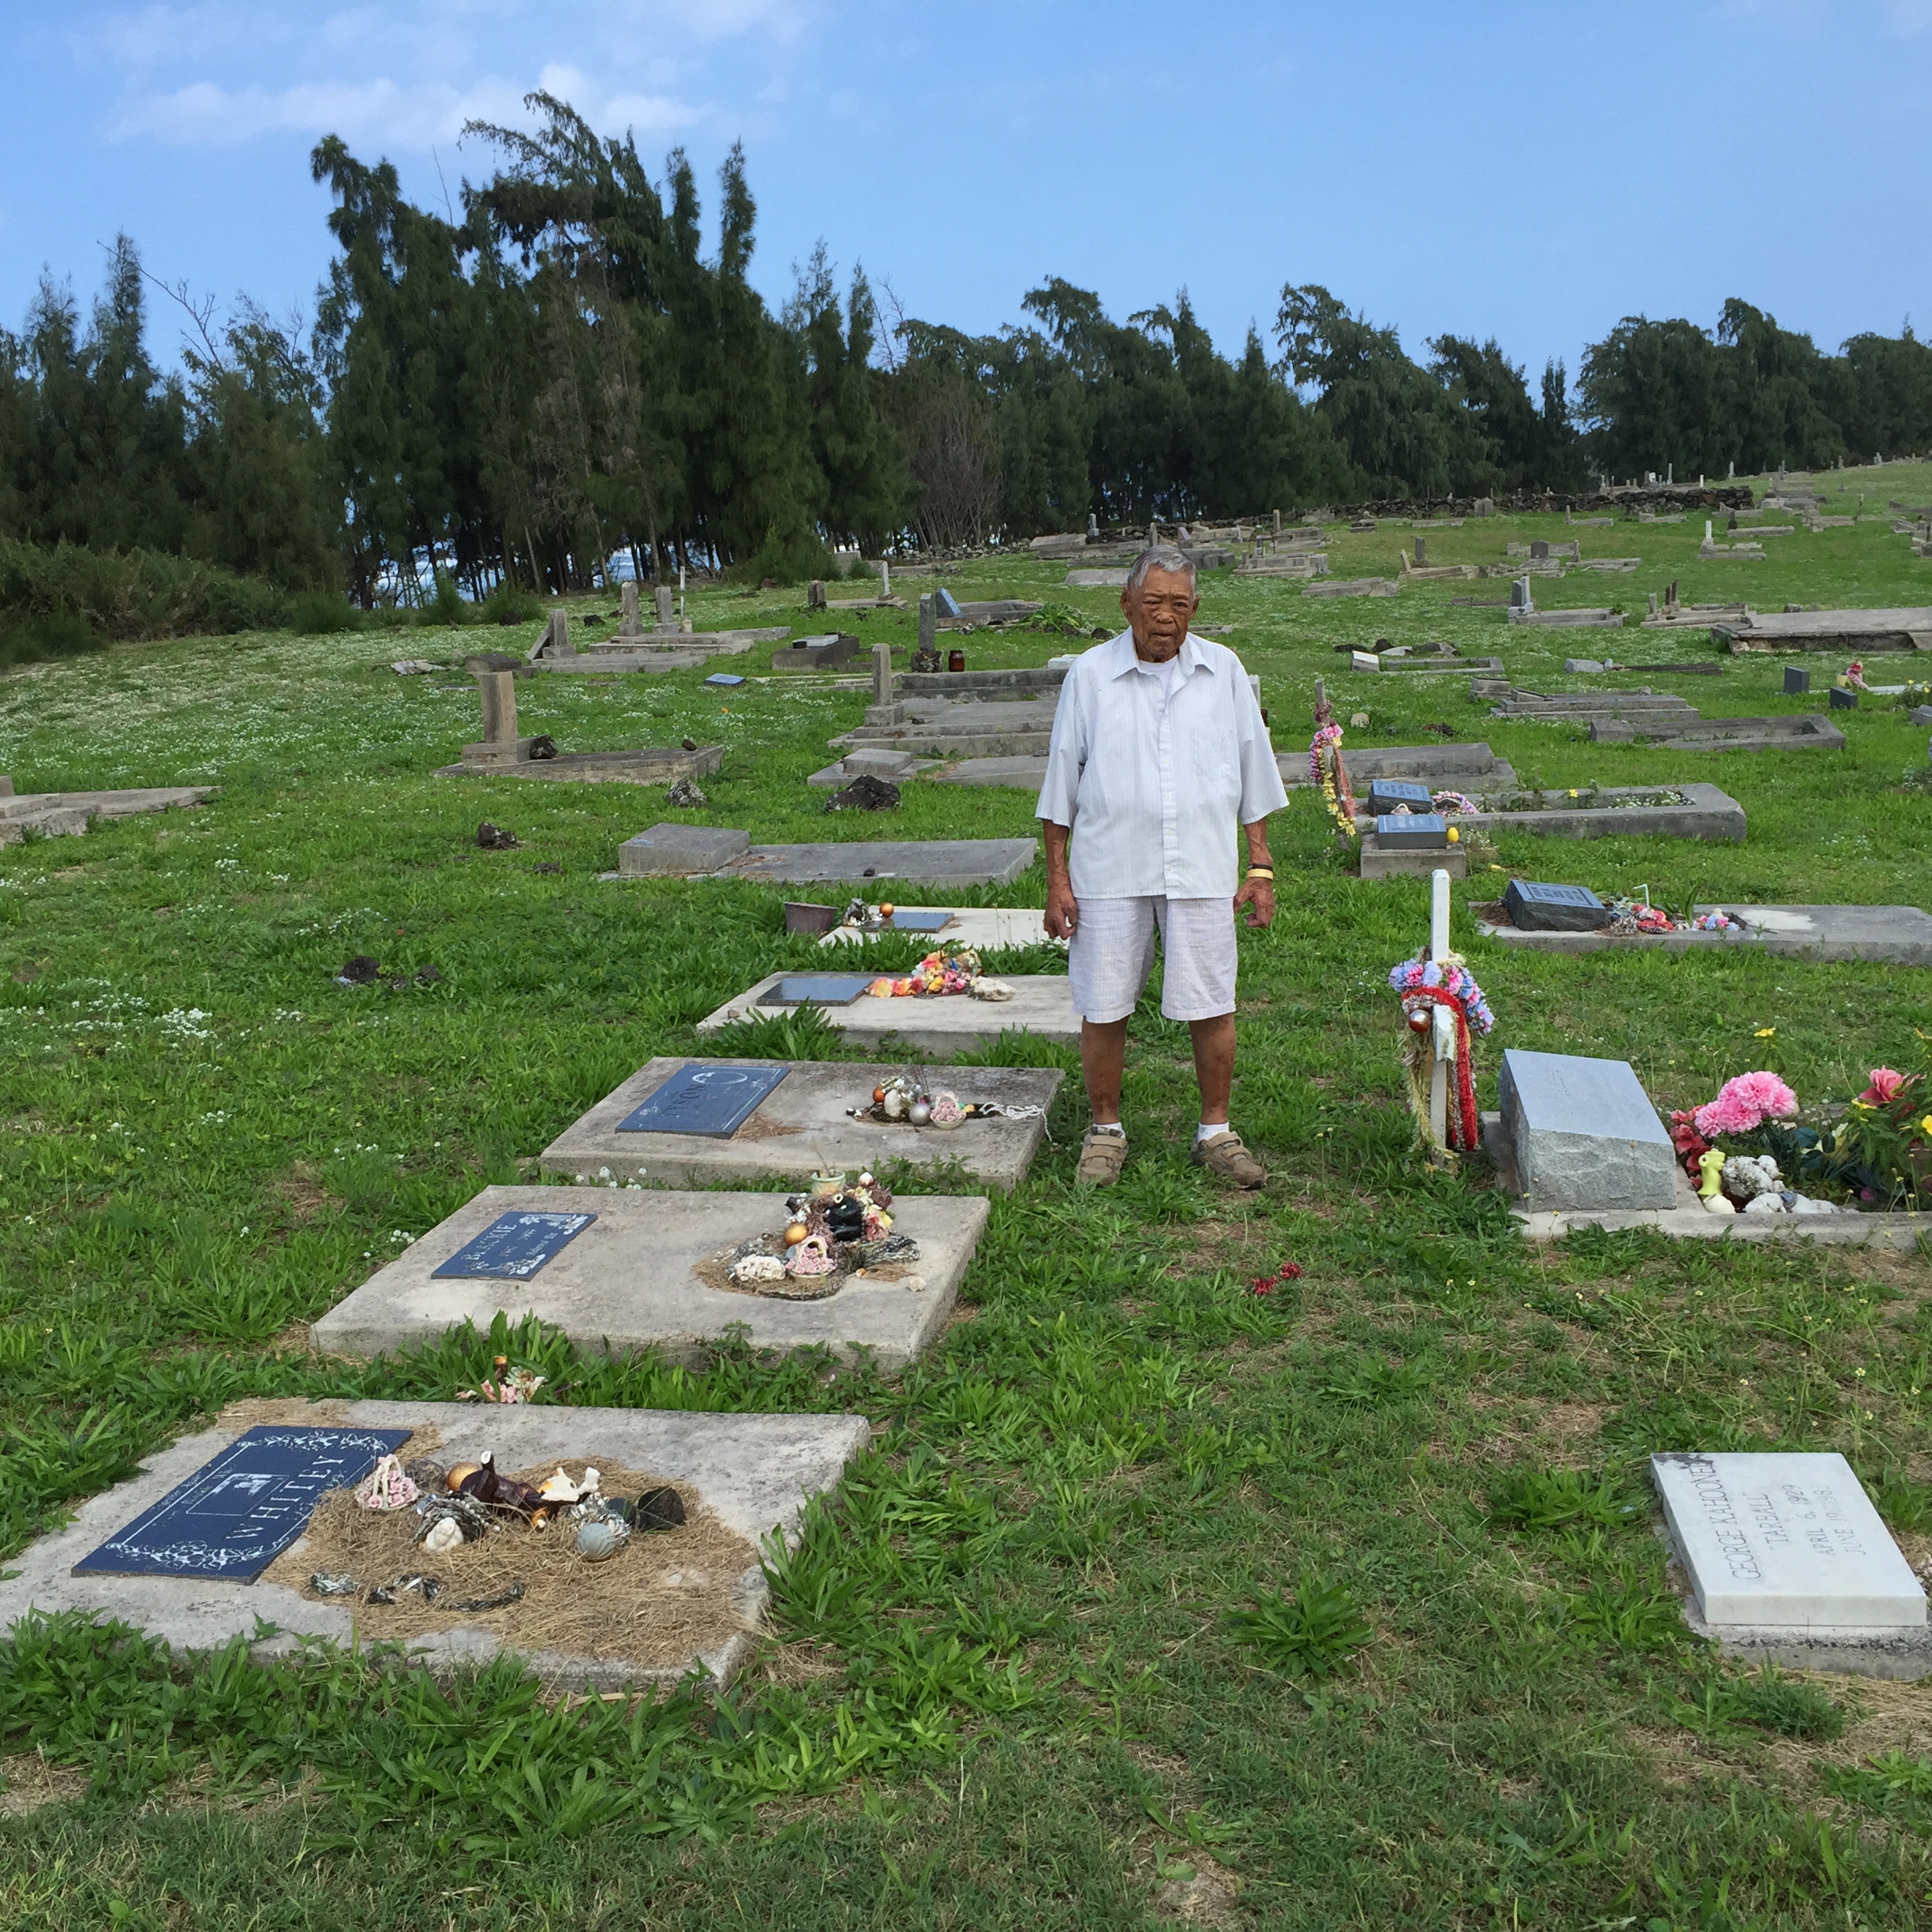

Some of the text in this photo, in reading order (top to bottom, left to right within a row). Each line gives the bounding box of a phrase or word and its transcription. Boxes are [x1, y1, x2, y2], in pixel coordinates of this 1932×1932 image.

[225, 1455, 346, 1540] WHITEY
[1782, 1485, 1810, 1505] 1929
[1715, 1529, 1762, 1580] GEORGE
[1806, 1527, 1837, 1556] APRIL
[1834, 1529, 1866, 1556] JUNE
